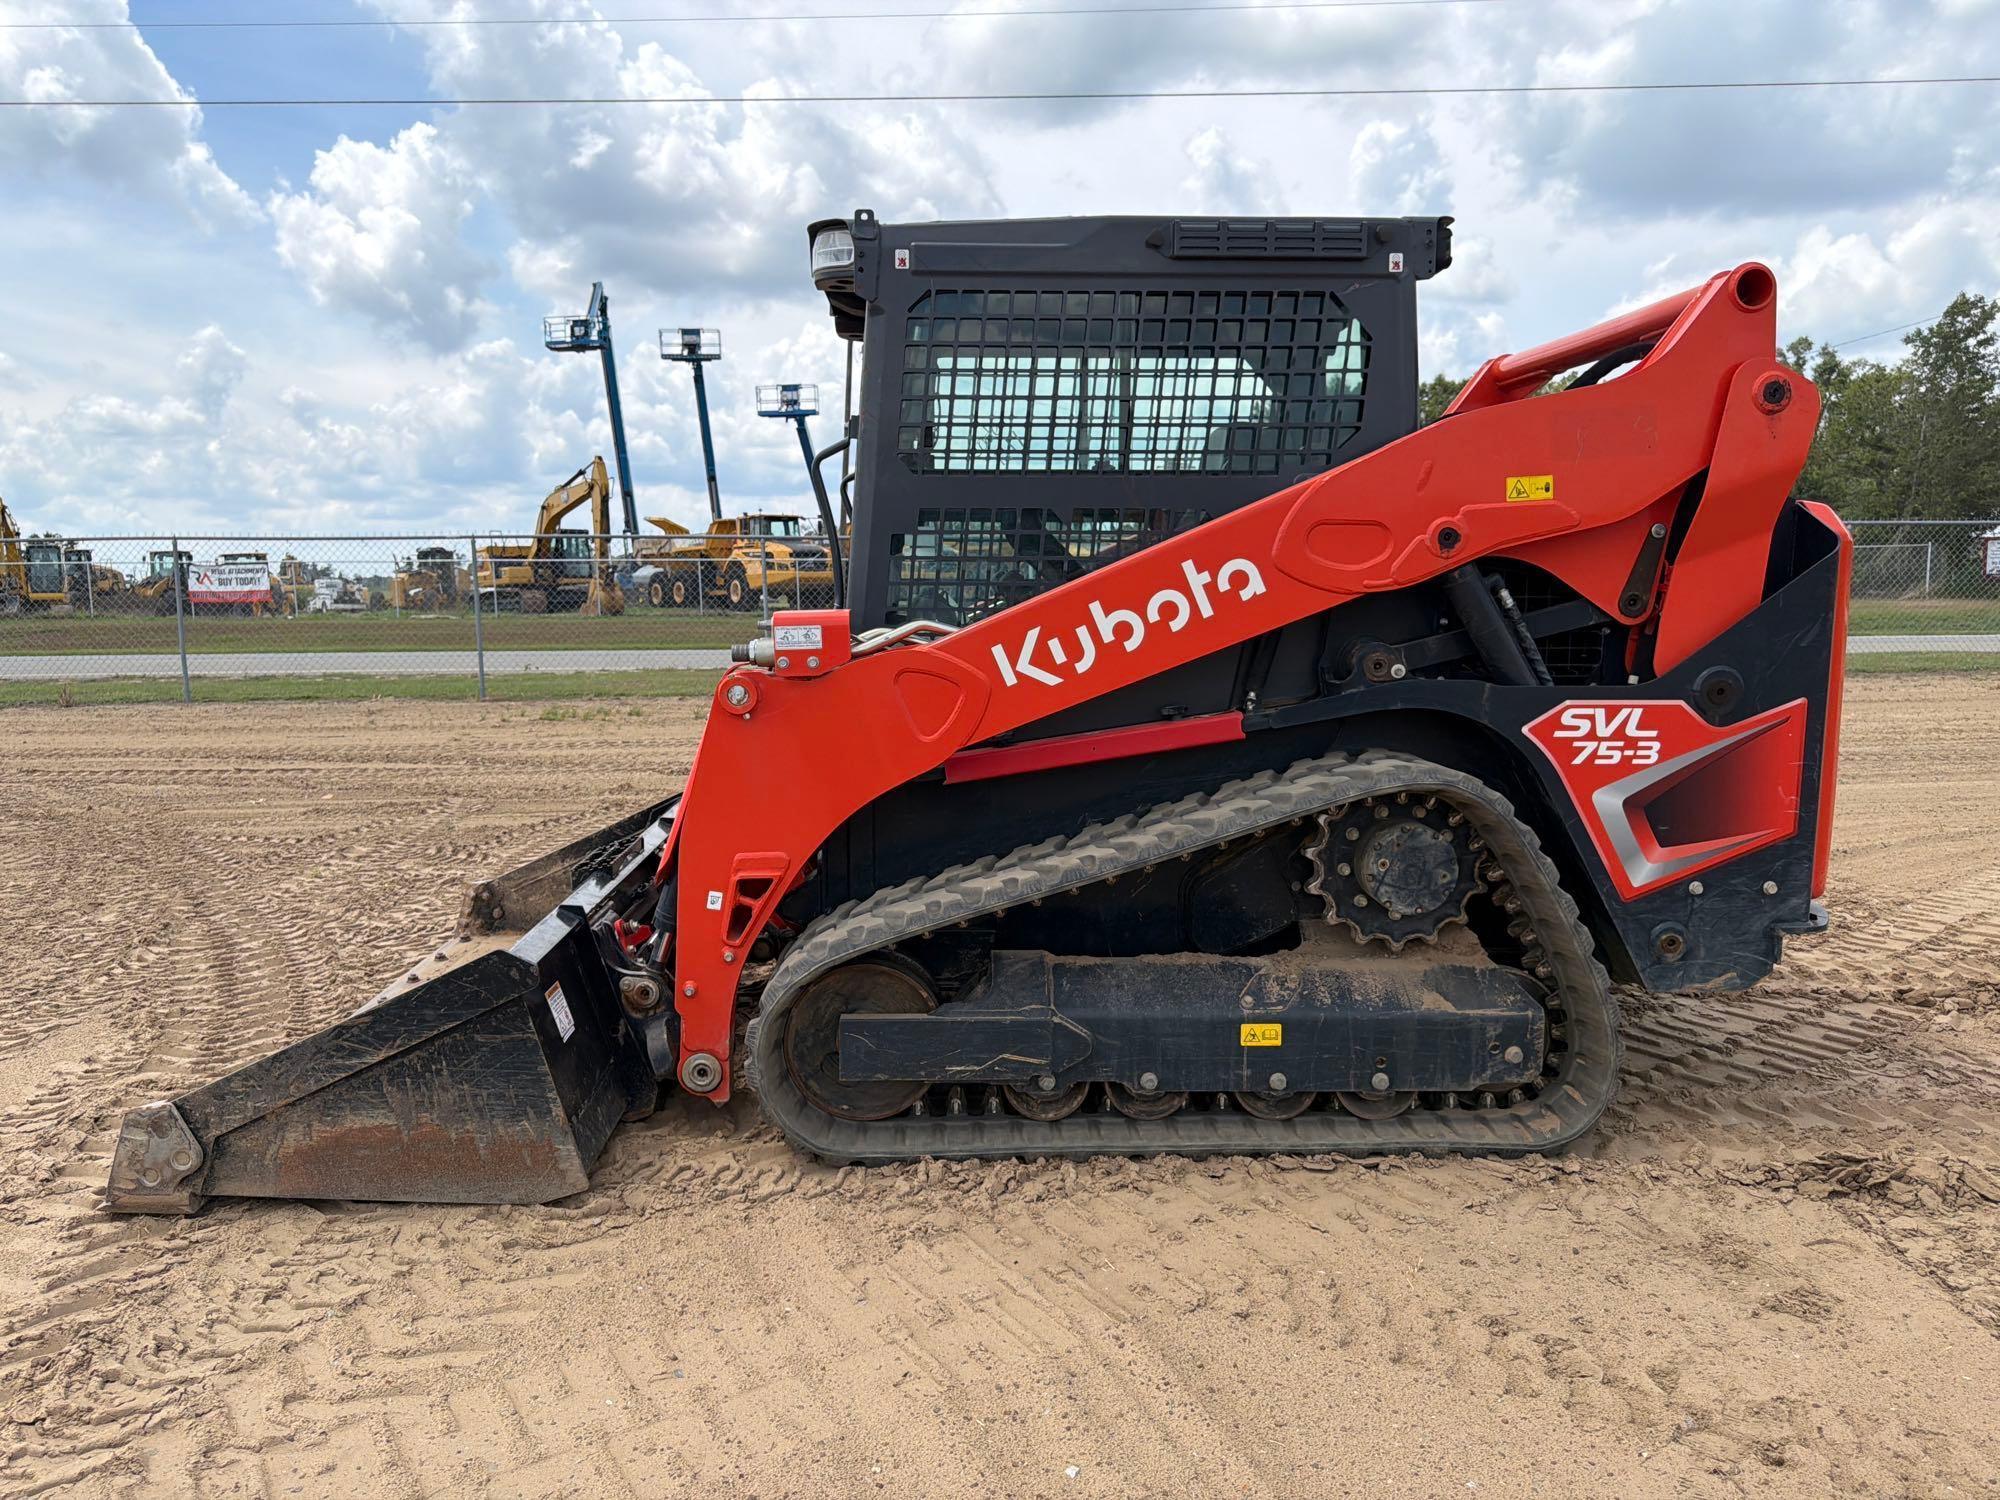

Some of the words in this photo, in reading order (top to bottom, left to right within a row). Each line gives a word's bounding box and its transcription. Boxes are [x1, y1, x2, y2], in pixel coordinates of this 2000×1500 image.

[218, 577, 233, 586] BUY
[991, 558, 1267, 687] Kubota
[1553, 708, 1658, 737] SVL
[1571, 741, 1661, 765] 75-3
